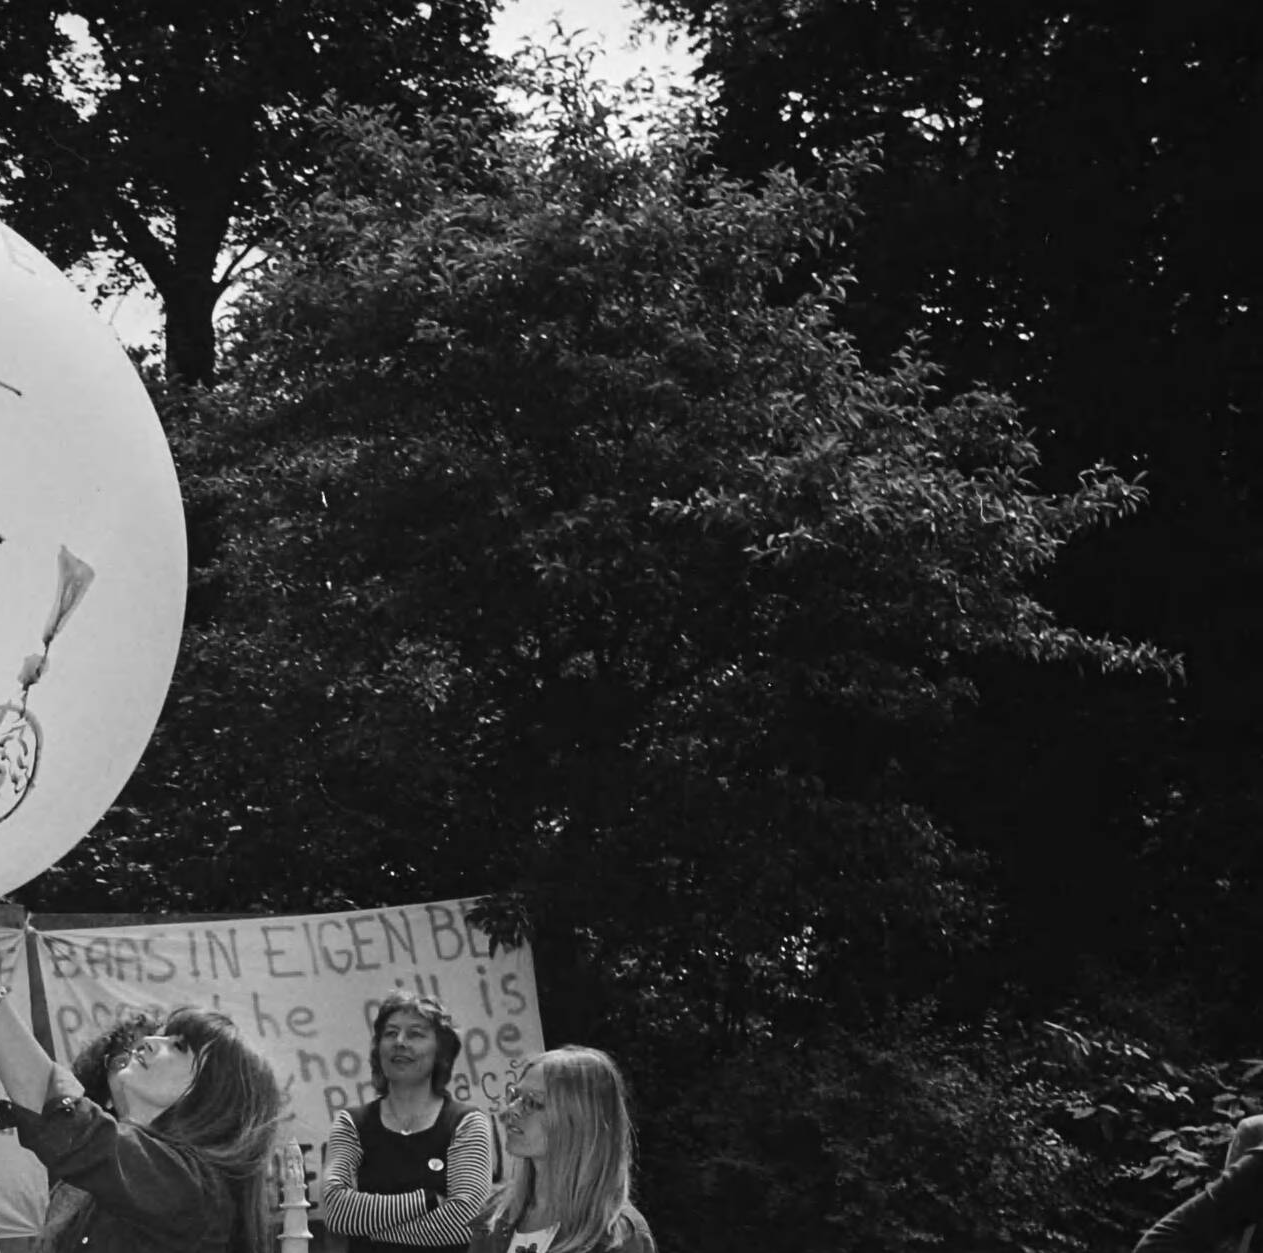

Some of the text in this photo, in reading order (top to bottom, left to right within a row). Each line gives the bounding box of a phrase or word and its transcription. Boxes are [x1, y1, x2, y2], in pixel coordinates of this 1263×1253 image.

[188, 927, 241, 979] IN
[261, 905, 418, 978] EIGEN
[476, 965, 528, 1018] is
[297, 1049, 363, 1083] no
